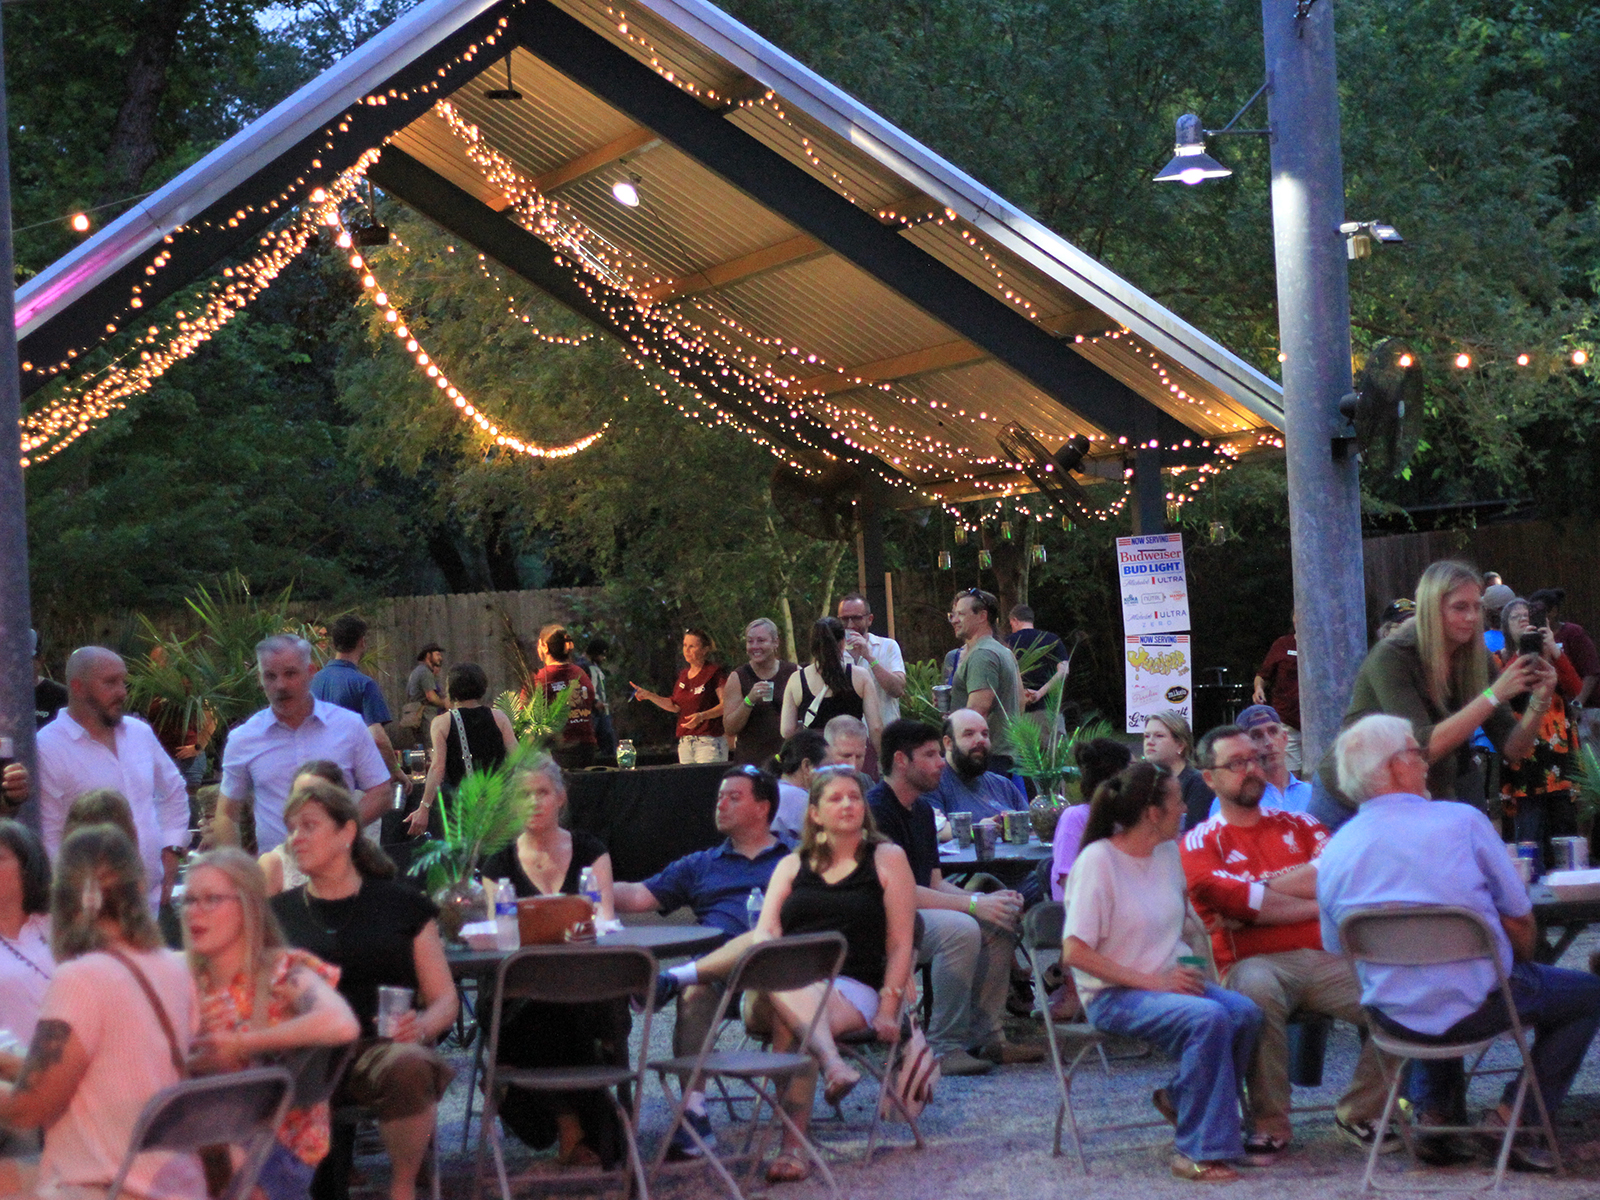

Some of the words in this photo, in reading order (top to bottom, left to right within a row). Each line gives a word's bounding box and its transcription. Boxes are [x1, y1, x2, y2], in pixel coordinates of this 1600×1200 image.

[1131, 536, 1145, 545] NOW
[1146, 535, 1170, 543] SERVING
[1120, 550, 1182, 562] Budweiser
[1123, 565, 1148, 575] BUD
[1149, 562, 1181, 573] LIGHT
[1157, 576, 1184, 584] ULTRA
[1159, 609, 1187, 618] ULTRA
[1142, 620, 1172, 628] ZERO
